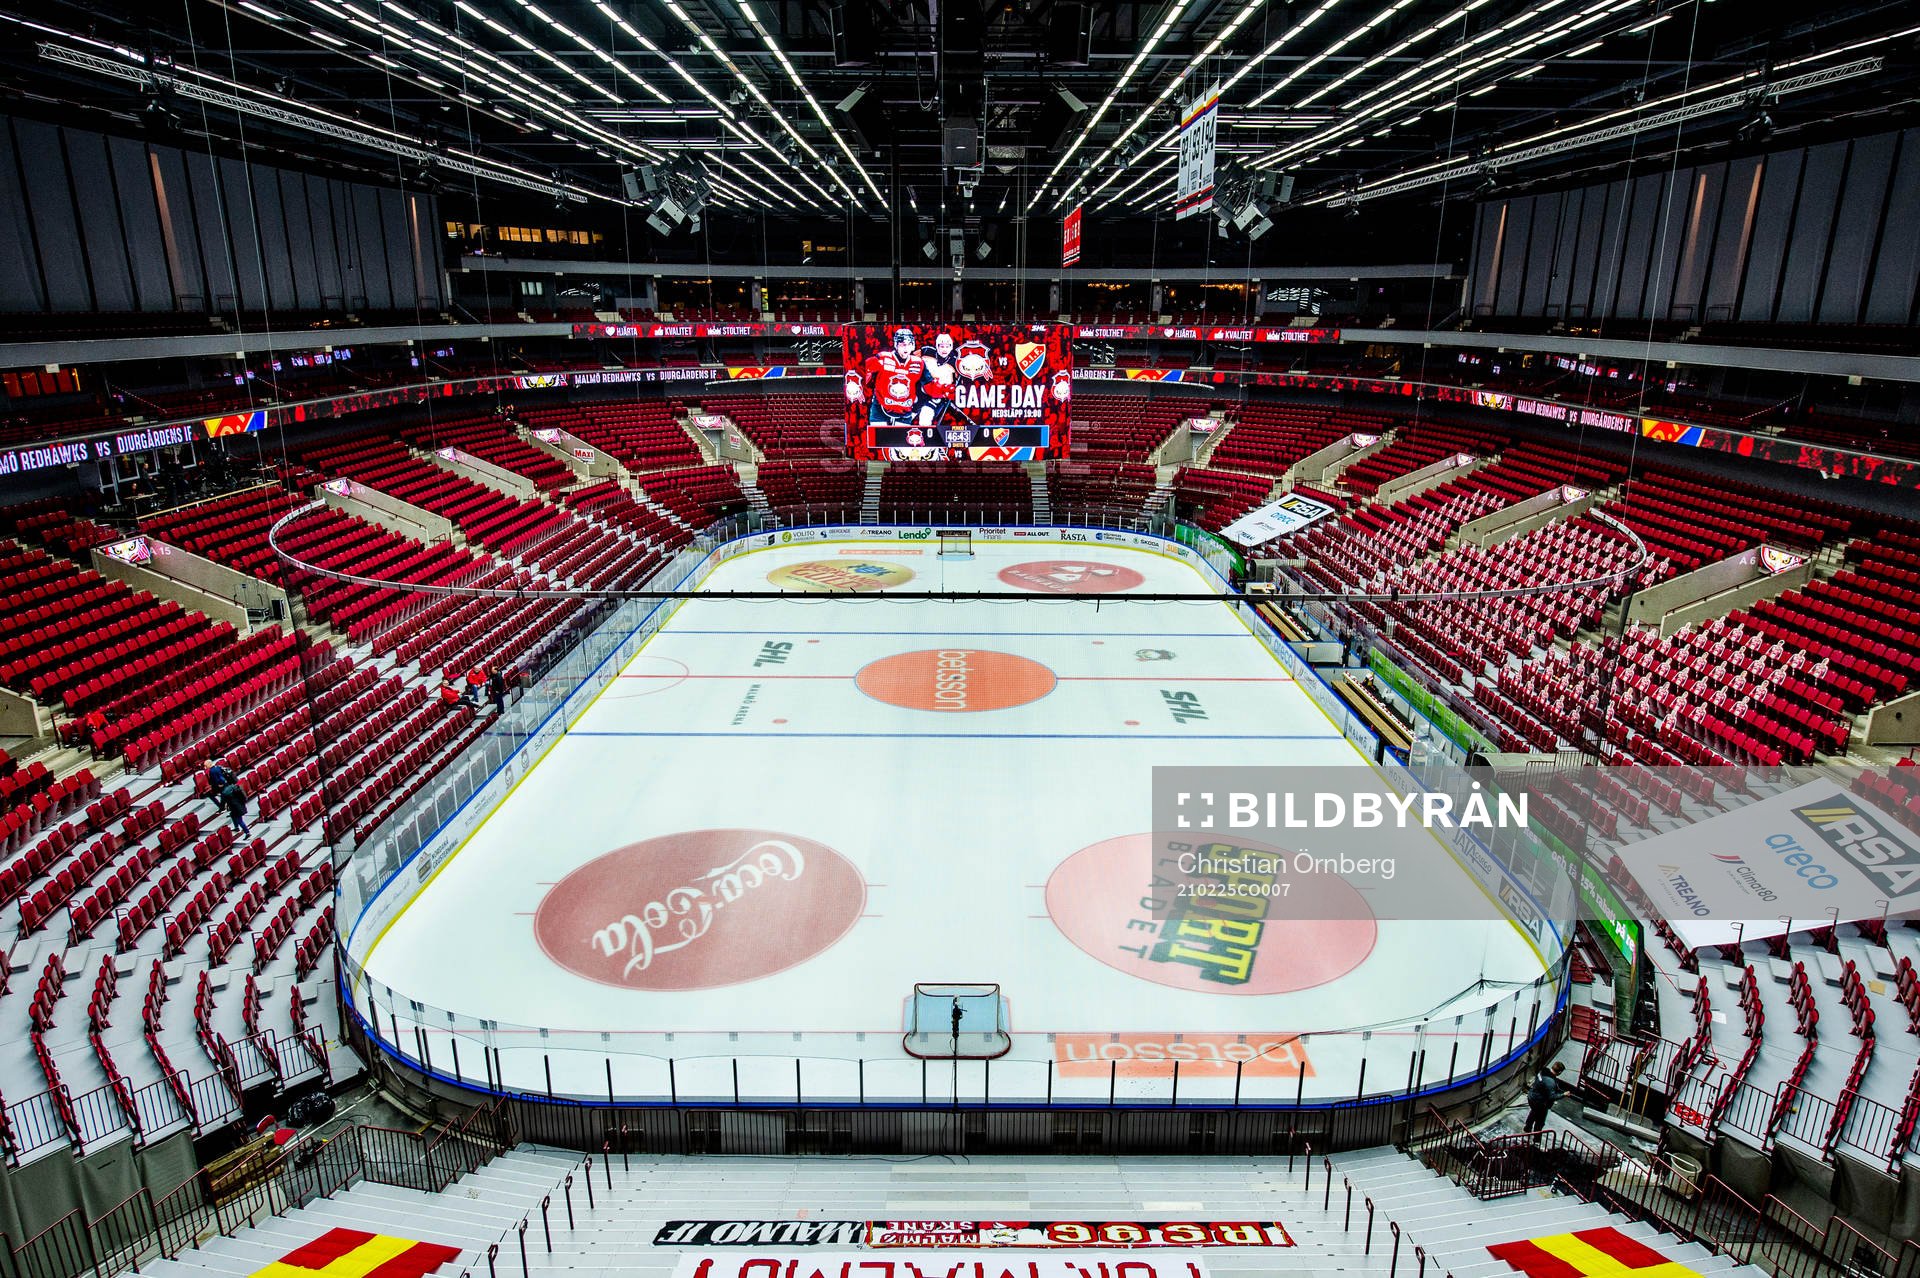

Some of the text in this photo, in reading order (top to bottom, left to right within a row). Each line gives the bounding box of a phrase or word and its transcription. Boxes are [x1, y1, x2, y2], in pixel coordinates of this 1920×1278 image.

[616, 327, 638, 336] HJÄRTA
[664, 326, 692, 336] KVALITET
[722, 326, 751, 335] STOLTHET
[802, 326, 825, 336] HJÄRTA
[1095, 328, 1124, 338] STOLTHET
[1174, 328, 1197, 339] HJÄRTA
[1225, 330, 1253, 340] KVALITET
[1280, 331, 1309, 342] STOLTHET
[999, 357, 1008, 366] VS
[574, 369, 717, 385] MALMÖ REDHAWKS VS DJURGÅRDENS IF
[955, 384, 1046, 409] GAME DAY
[992, 407, 1042, 418] NEDSLÄPP 19:00
[1516, 399, 1633, 432] MALMÖ REDHAWKS VS DJURGÅRDENS IF
[927, 428, 933, 438] 0
[983, 428, 989, 438] 0
[20, 442, 89, 471] REDHAWKS
[95, 441, 111, 458] VS
[117, 425, 184, 454] DJURGÅRDENS
[183, 425, 193, 442] IF
[574, 448, 595, 459] MAXI
[954, 450, 963, 458] VS
[793, 530, 815, 538] VOLITO
[898, 530, 927, 540] Lendo
[979, 527, 1006, 535] Prioritet
[1060, 532, 1087, 542] RASTA
[160, 546, 172, 556] 15
[1738, 556, 1757, 565] A 6
[752, 640, 794, 668] SHL
[933, 649, 975, 710] betsson
[1159, 689, 1210, 724] SHL
[1819, 814, 1920, 895] RSA
[1473, 849, 1492, 874] CARGO
[1764, 833, 1839, 890] areco
[1736, 864, 1778, 903] Climat80
[1118, 840, 1193, 960] BLADET
[1668, 874, 1711, 917] TREANO
[591, 839, 805, 980] Coca-Cola
[1154, 842, 1284, 985] SPORT
[1507, 889, 1541, 938] RSA
[1595, 892, 1616, 927] rabatt
[1615, 920, 1627, 942] på
[1066, 1042, 1299, 1069] betsson
[659, 1221, 707, 1243] IF
